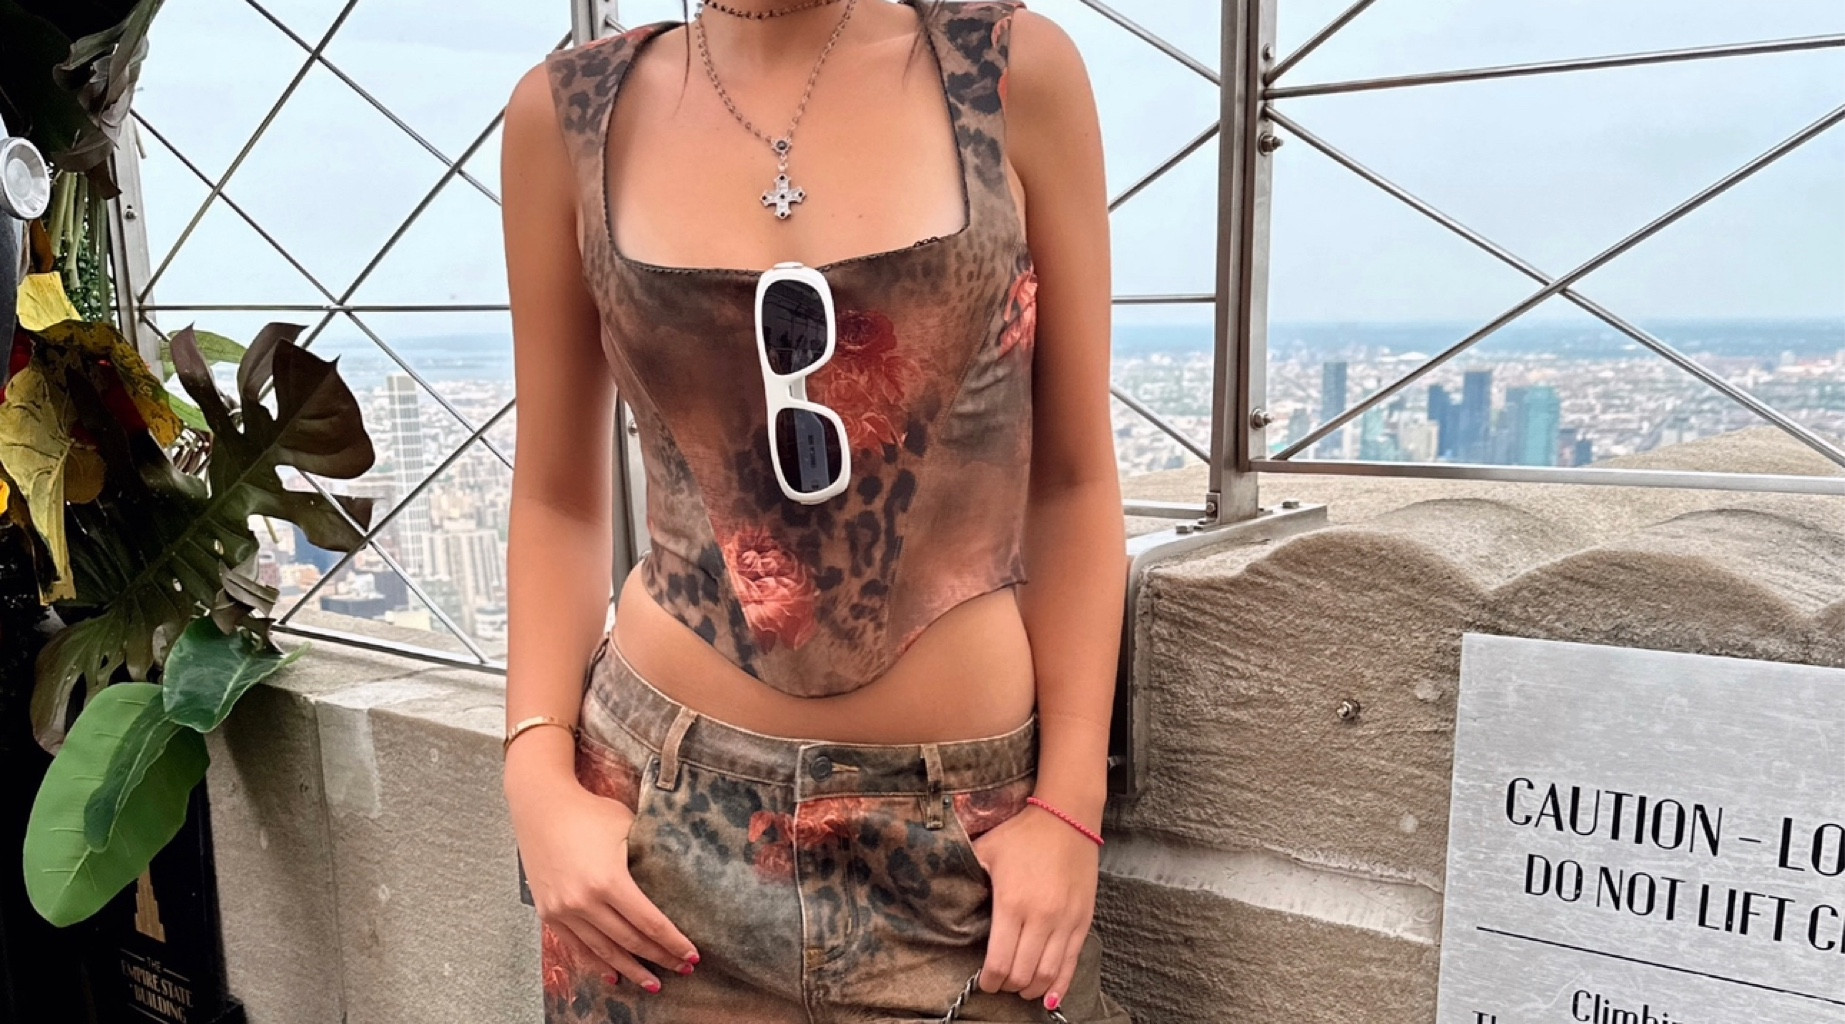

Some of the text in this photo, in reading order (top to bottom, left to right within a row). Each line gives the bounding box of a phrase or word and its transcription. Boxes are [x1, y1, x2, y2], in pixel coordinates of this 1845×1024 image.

[1505, 777, 1723, 857] CAUTION
[1525, 853, 1584, 902] DO
[1596, 866, 1686, 921] NOT
[1698, 883, 1796, 942] LIFT
[121, 959, 193, 1008] EMPIRE STATE
[133, 984, 187, 1024] BUILDING
